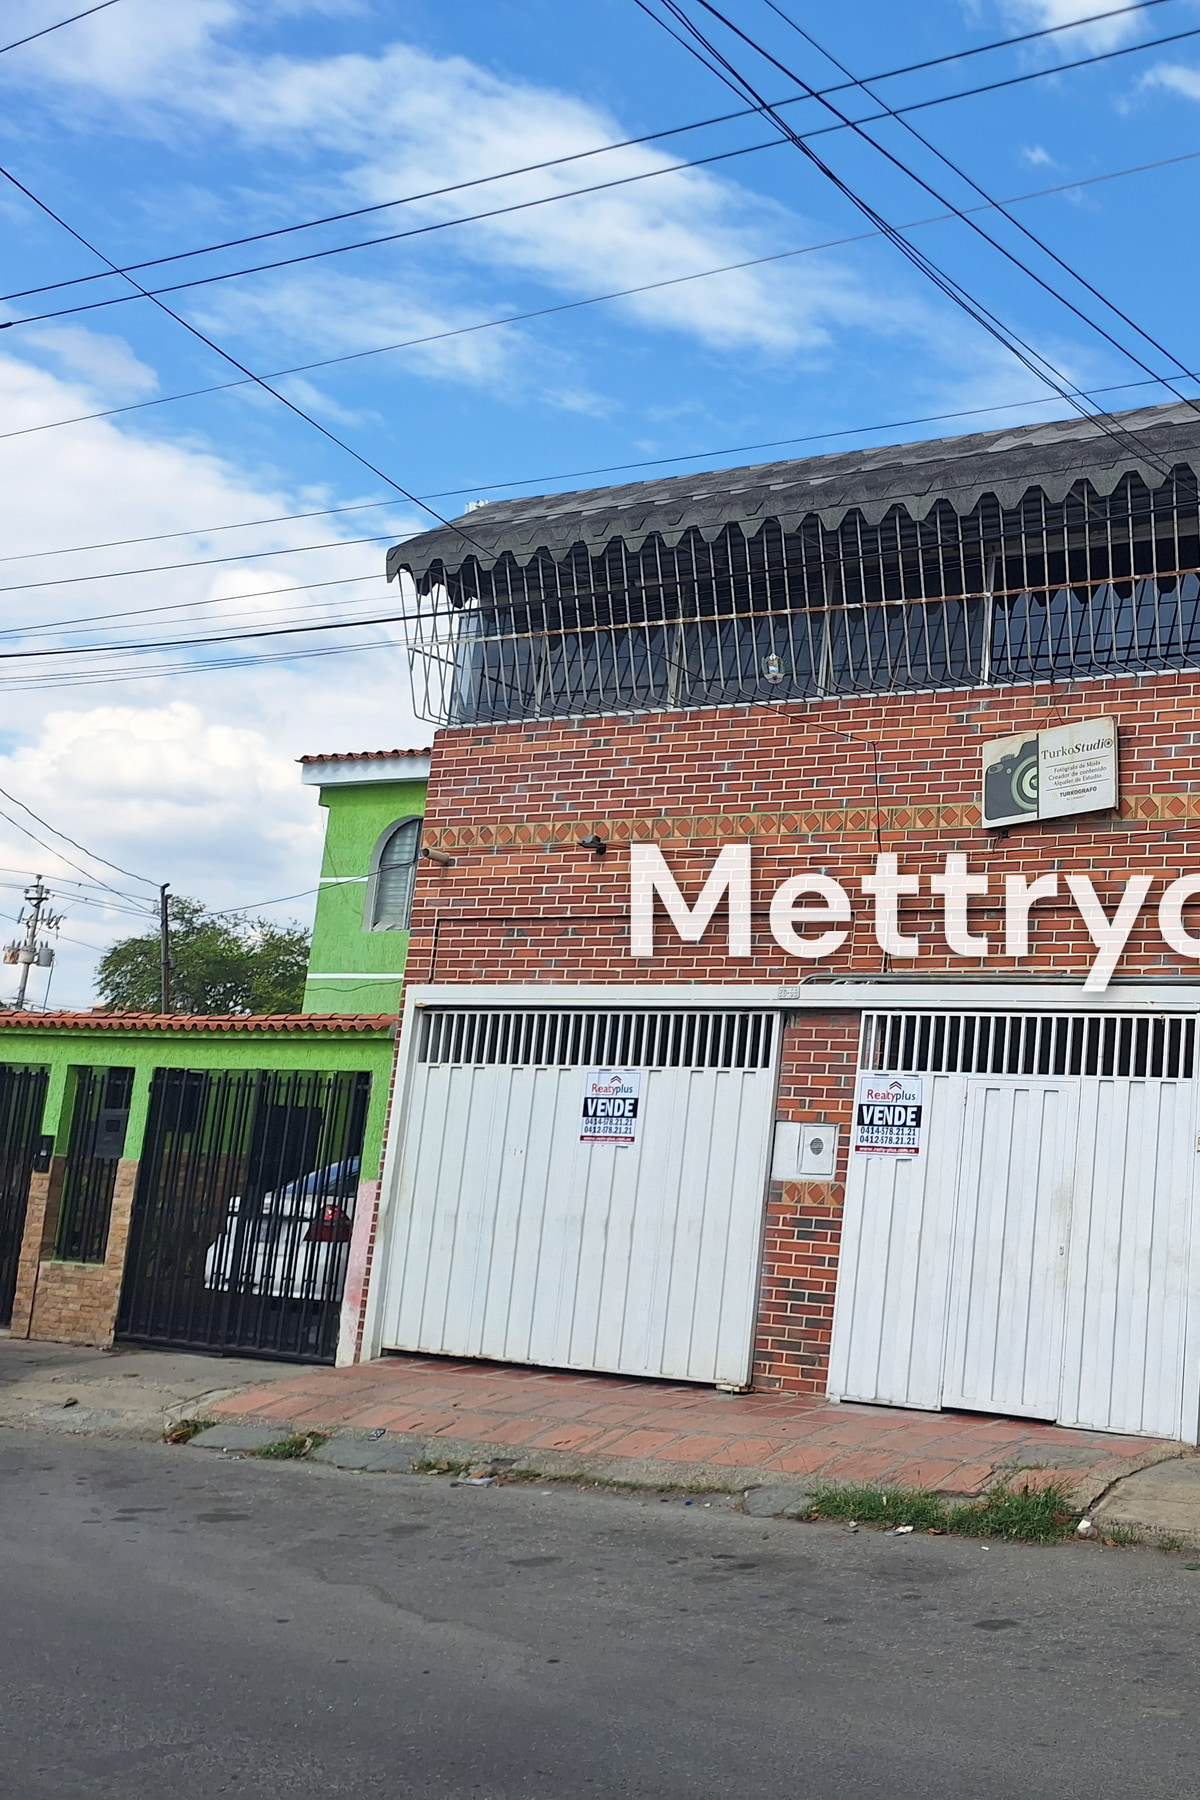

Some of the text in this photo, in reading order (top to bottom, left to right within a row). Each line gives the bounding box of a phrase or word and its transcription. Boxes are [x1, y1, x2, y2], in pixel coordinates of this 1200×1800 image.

[1048, 772, 1070, 781] Creador
[1079, 766, 1107, 775] contenido
[1053, 779, 1074, 787] Alquiler
[1082, 773, 1102, 782] Estudio
[1060, 786, 1098, 798] TURKOGRAFO
[587, 1098, 635, 1117] VENDE
[862, 1105, 918, 1126] VENDE
[860, 1126, 916, 1136] 0414-578.21.21
[859, 1135, 916, 1145] 0412-578.21.21
